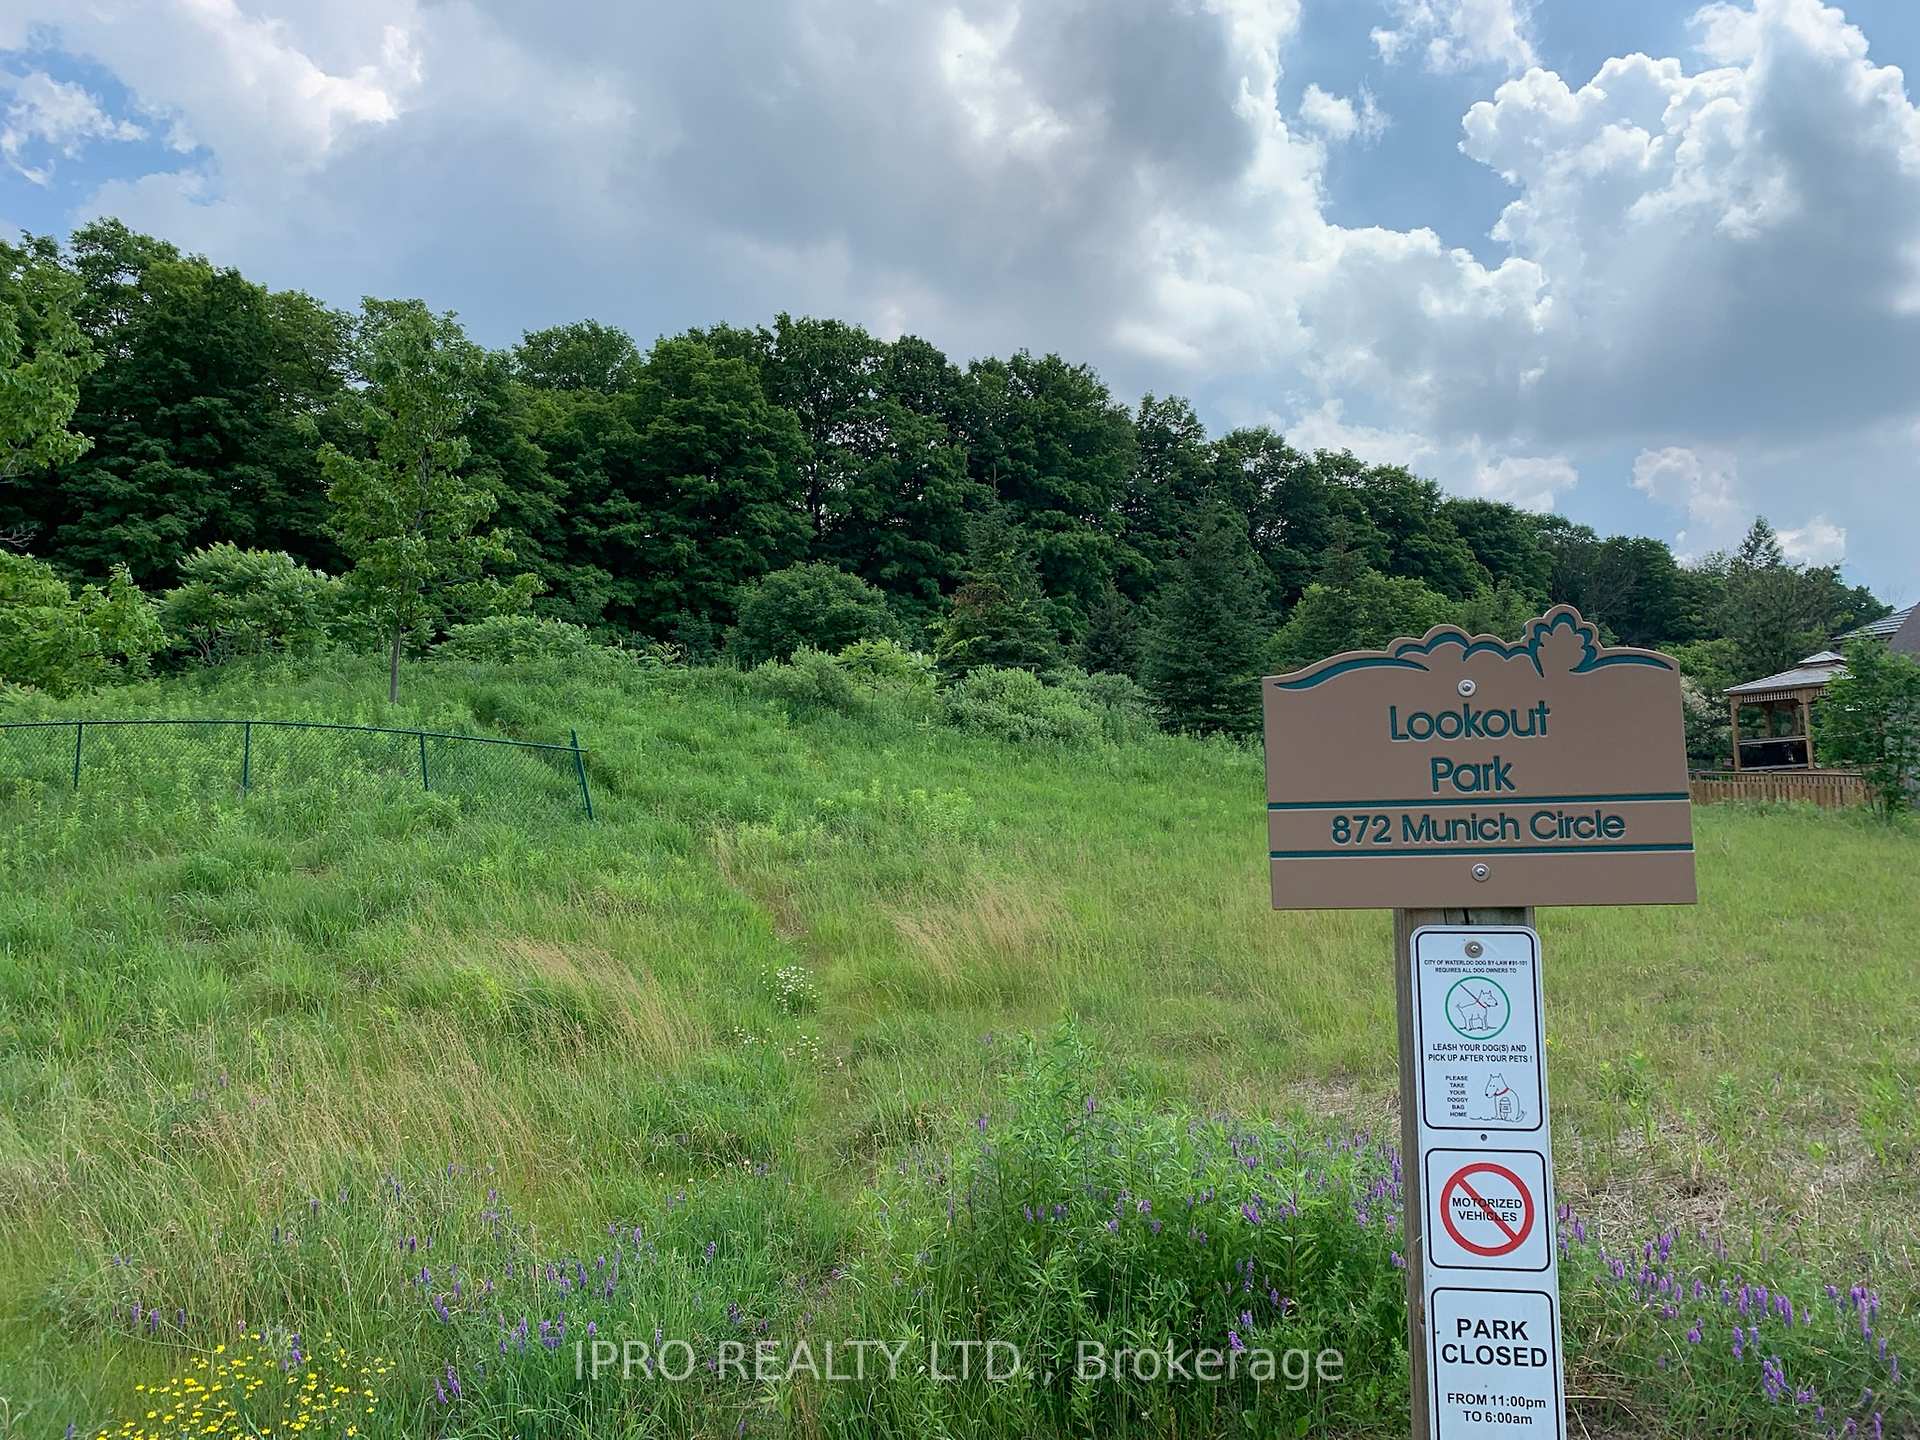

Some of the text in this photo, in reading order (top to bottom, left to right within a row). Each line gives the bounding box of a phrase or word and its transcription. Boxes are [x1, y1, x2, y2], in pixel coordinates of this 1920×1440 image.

[1390, 701, 1551, 741] Lookout
[1431, 756, 1516, 793] Park
[1332, 809, 1626, 845] 872 Munich Circle
[1432, 1043, 1457, 1051] LEASH
[1482, 1044, 1509, 1053] DOG(S)
[1508, 1055, 1528, 1063] PETS
[1452, 1197, 1523, 1209] MOTORIZED
[1458, 1210, 1517, 1222] VEHICLES
[1457, 1318, 1529, 1341] PARK
[1441, 1343, 1547, 1368] CLOSED
[1447, 1392, 1546, 1409] FROM 11:00pm
[1463, 1411, 1533, 1425] TO 6:00am
